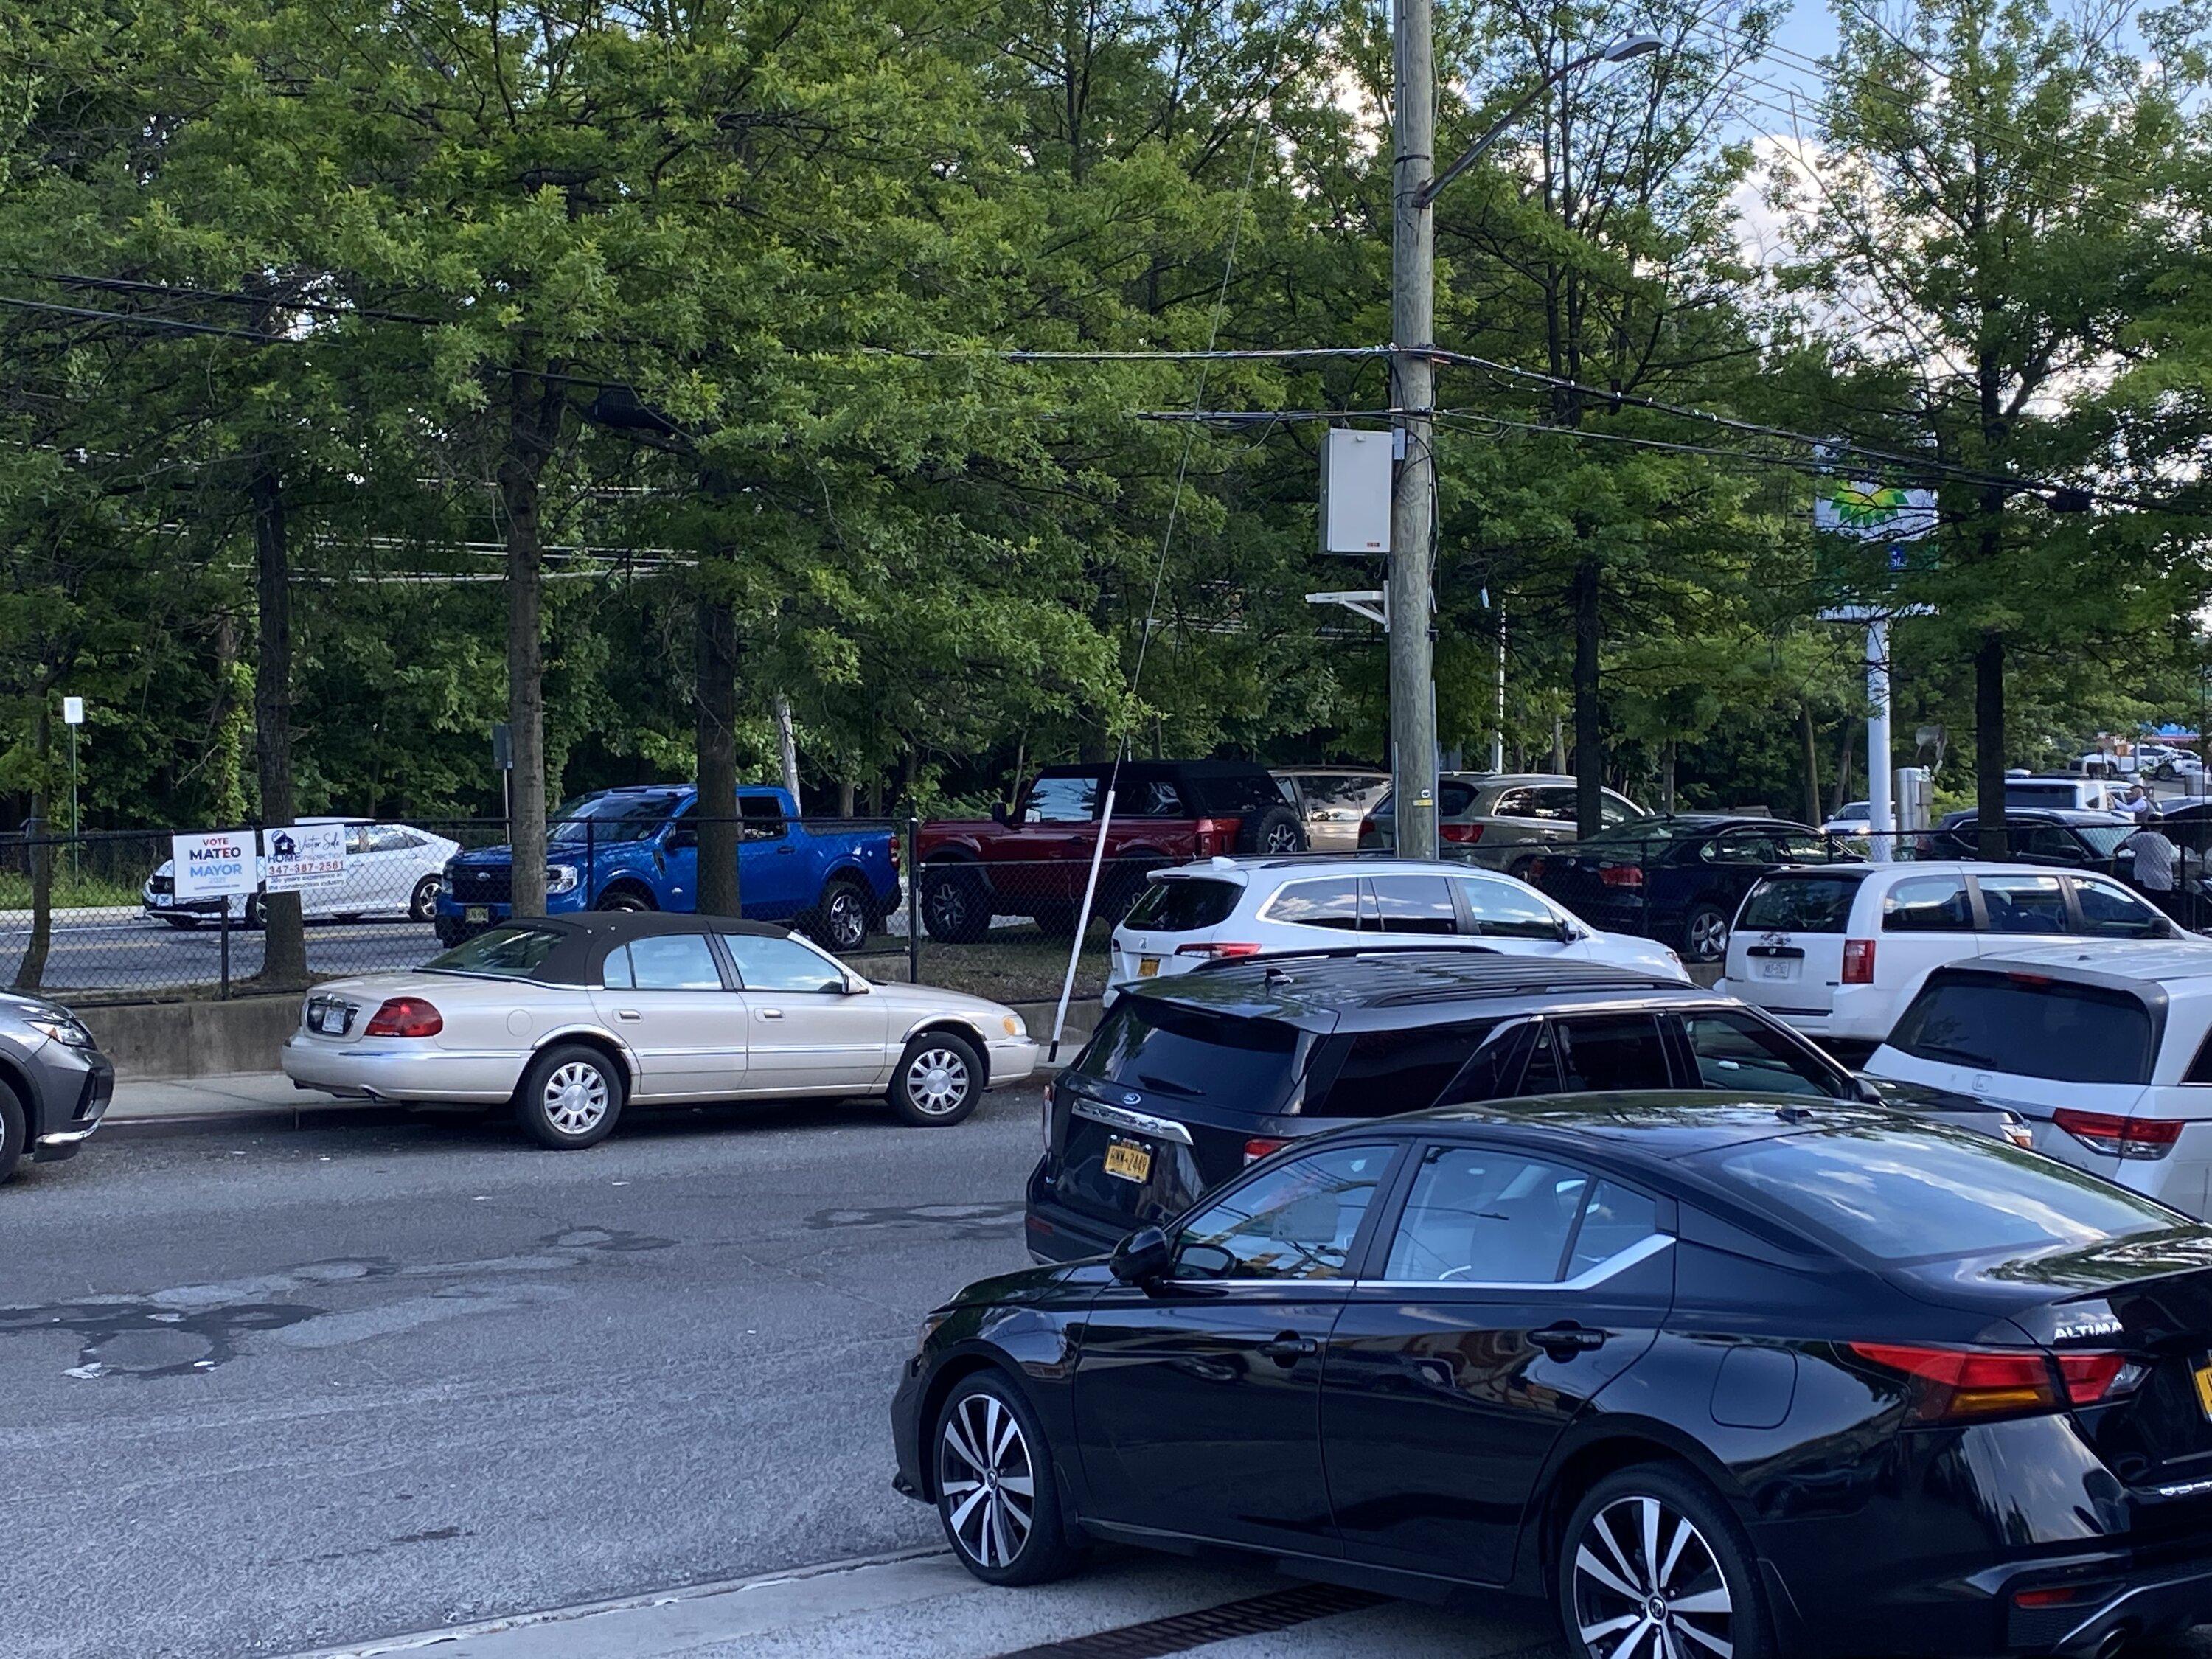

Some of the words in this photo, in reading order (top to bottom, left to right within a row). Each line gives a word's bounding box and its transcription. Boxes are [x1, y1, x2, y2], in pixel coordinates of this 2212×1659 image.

[203, 838, 229, 846] VOTE
[189, 846, 241, 860] MATEO
[190, 863, 242, 877] MAYOR
[2054, 1321, 2124, 1340] ALTIMA
